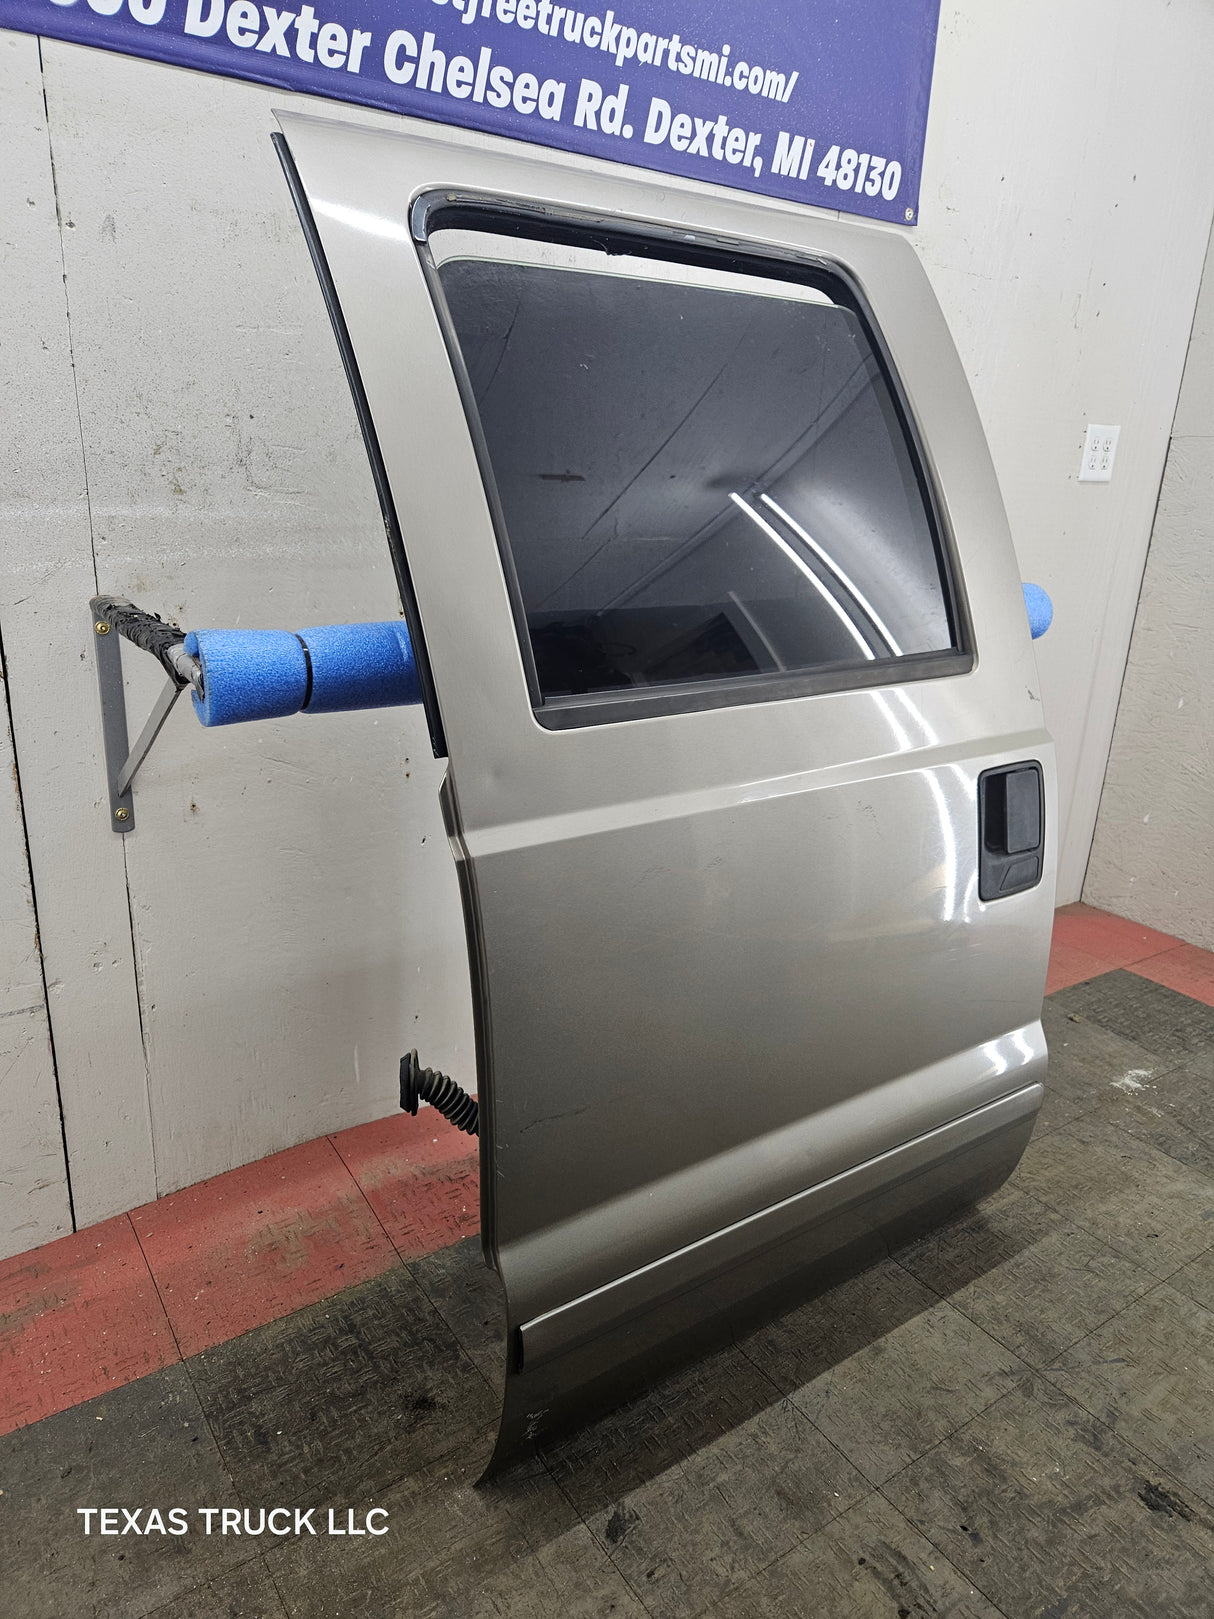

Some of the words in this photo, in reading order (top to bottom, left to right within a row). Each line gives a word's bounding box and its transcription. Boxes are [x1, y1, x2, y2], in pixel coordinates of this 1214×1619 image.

[184, 0, 372, 74] Dexter
[383, 29, 567, 121] Chelsea
[573, 79, 633, 138] Rd.
[644, 97, 763, 178] Dexter,
[770, 131, 815, 180] MI
[816, 145, 902, 201] 48130
[432, 0, 799, 102] eetruckpartsmi.com/
